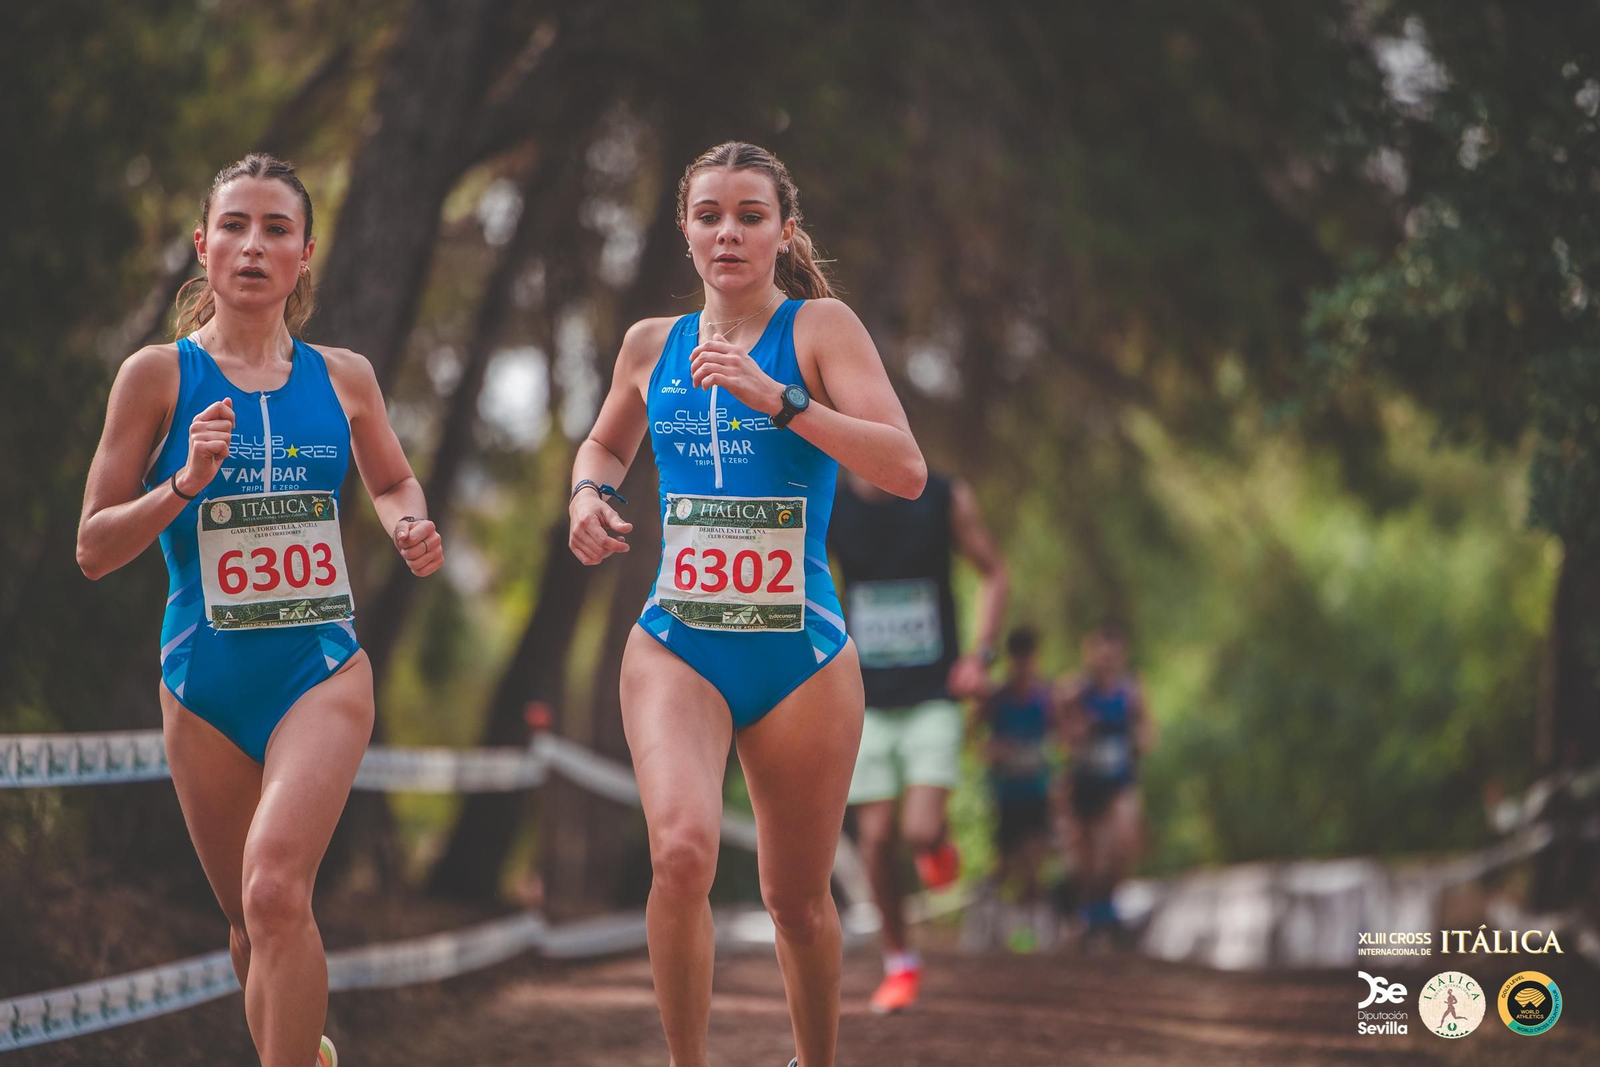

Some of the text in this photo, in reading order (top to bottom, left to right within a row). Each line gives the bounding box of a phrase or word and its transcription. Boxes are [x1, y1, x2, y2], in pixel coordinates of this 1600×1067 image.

[674, 408, 728, 422] CLUB
[688, 440, 756, 458] AMBAR
[695, 457, 727, 466] TRIPLE
[236, 466, 308, 484] AMBAR
[241, 498, 308, 518] ITÁLICA
[700, 501, 768, 519] ITÁLICA
[217, 542, 337, 595] 6303
[673, 547, 795, 594] 6302
